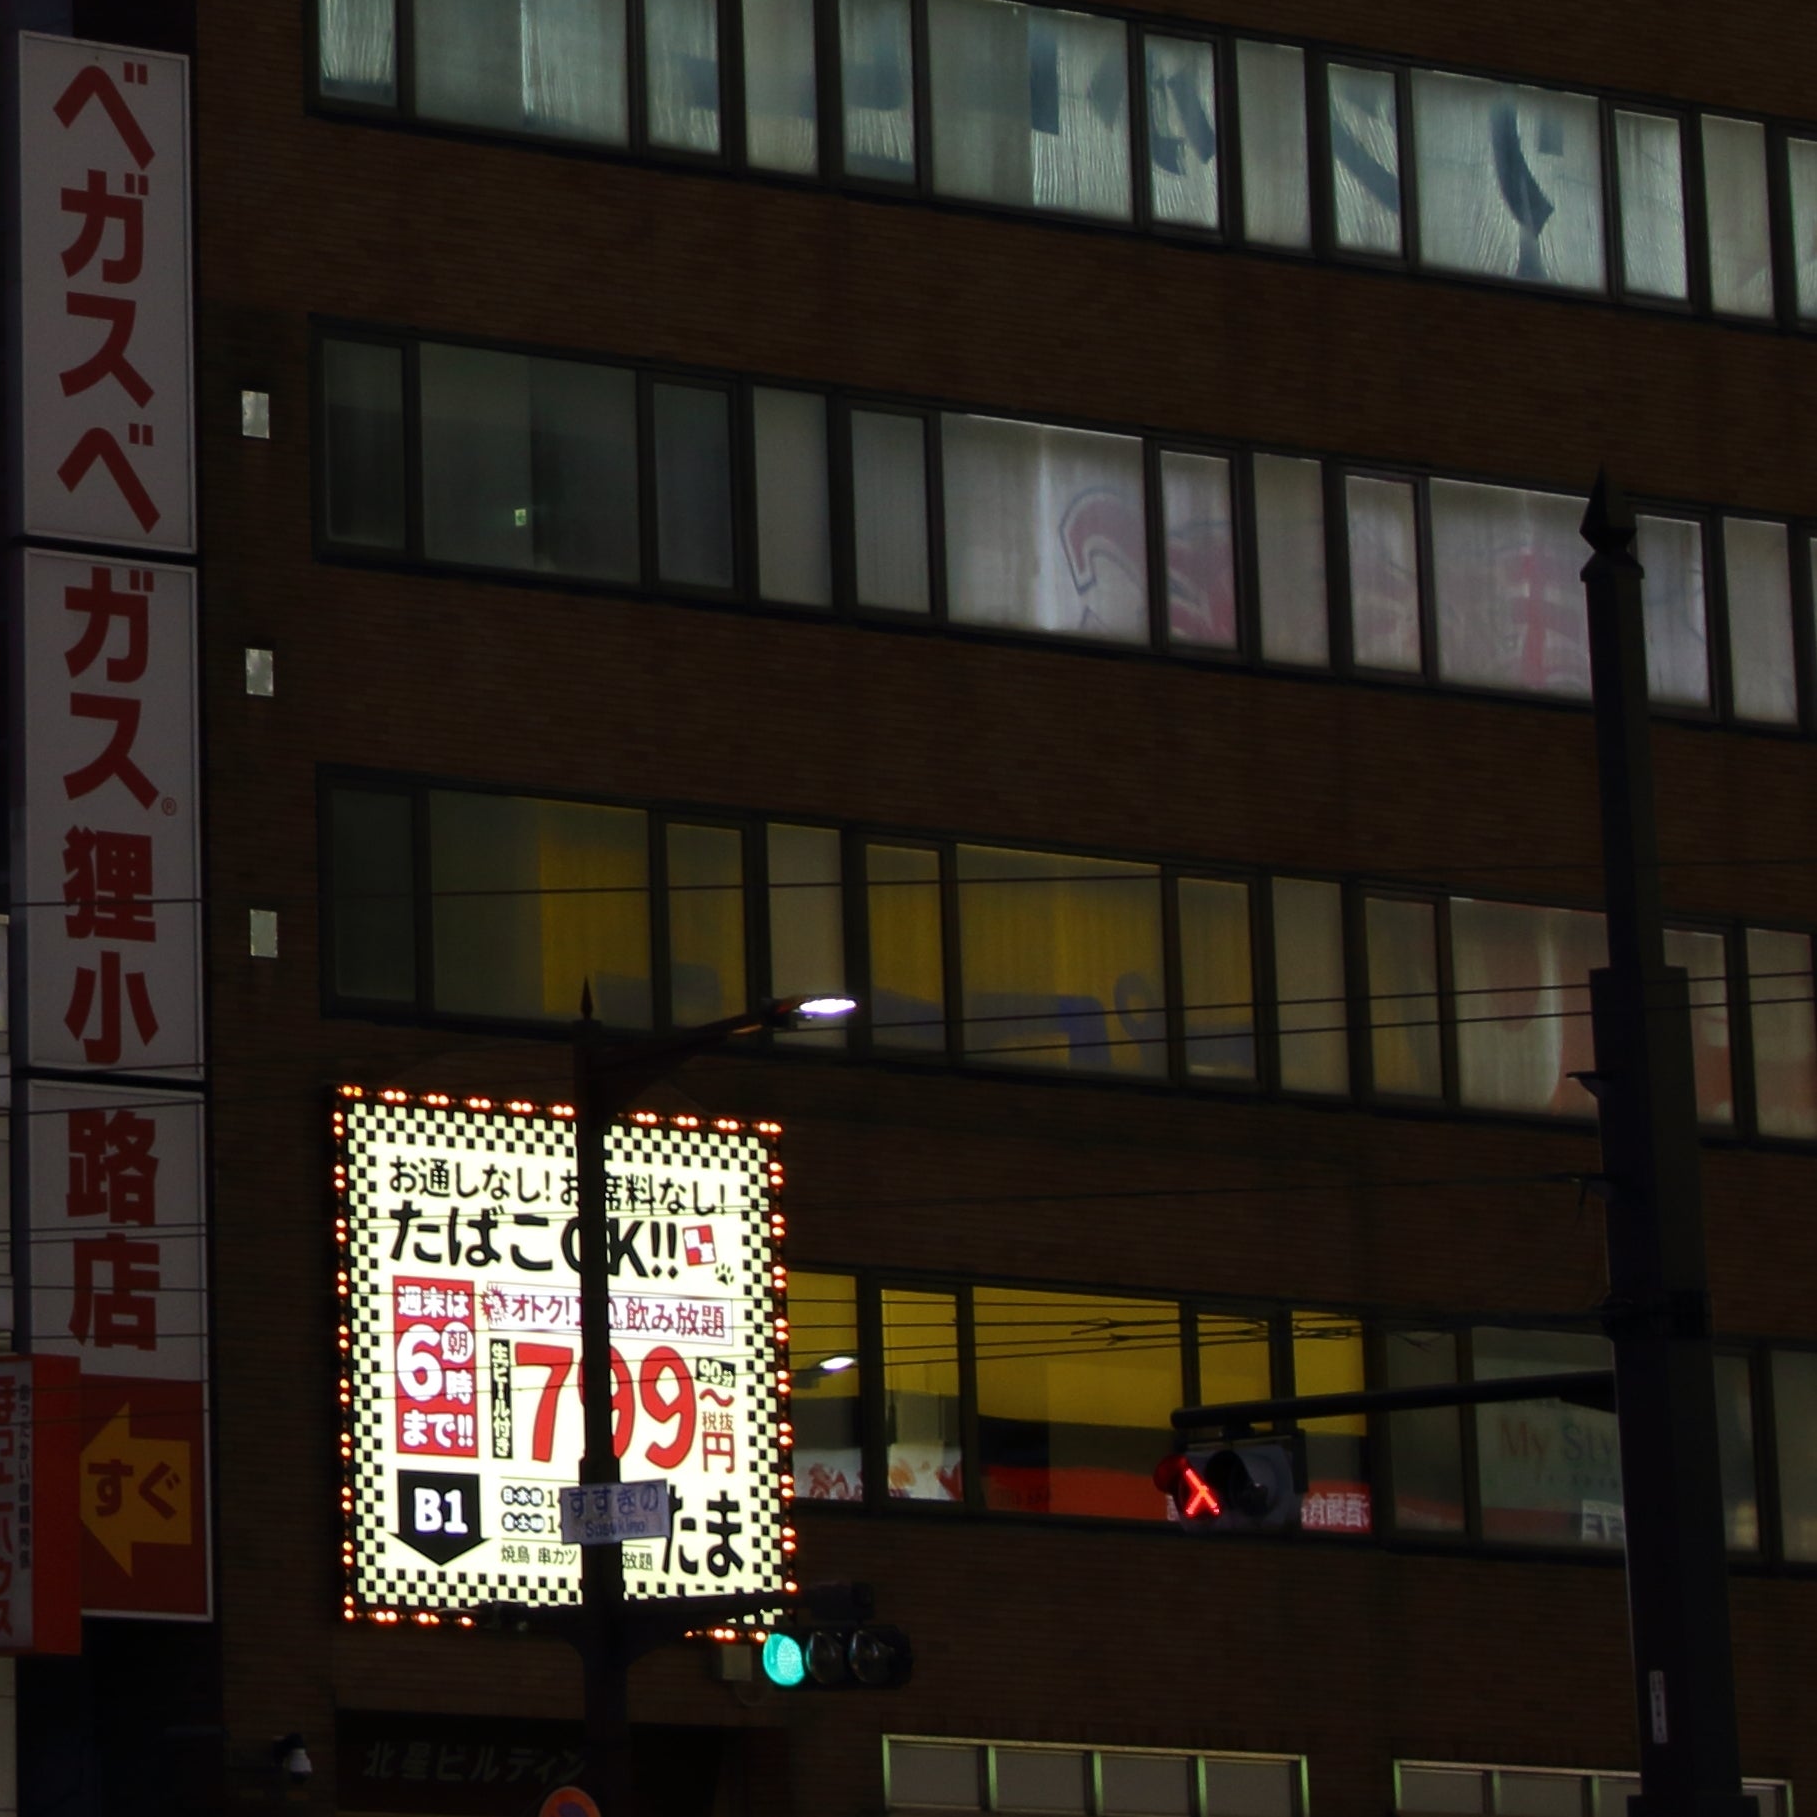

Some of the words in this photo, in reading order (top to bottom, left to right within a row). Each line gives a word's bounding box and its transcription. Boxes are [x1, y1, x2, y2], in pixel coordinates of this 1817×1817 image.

[62, 825, 161, 1352] 狸小路店
[398, 1286, 470, 1319] 週末は
[701, 1430, 736, 1475] 円
[87, 1458, 180, 1521] すぐ
[413, 1486, 470, 1534] B1
[568, 1484, 659, 1519] すすきの
